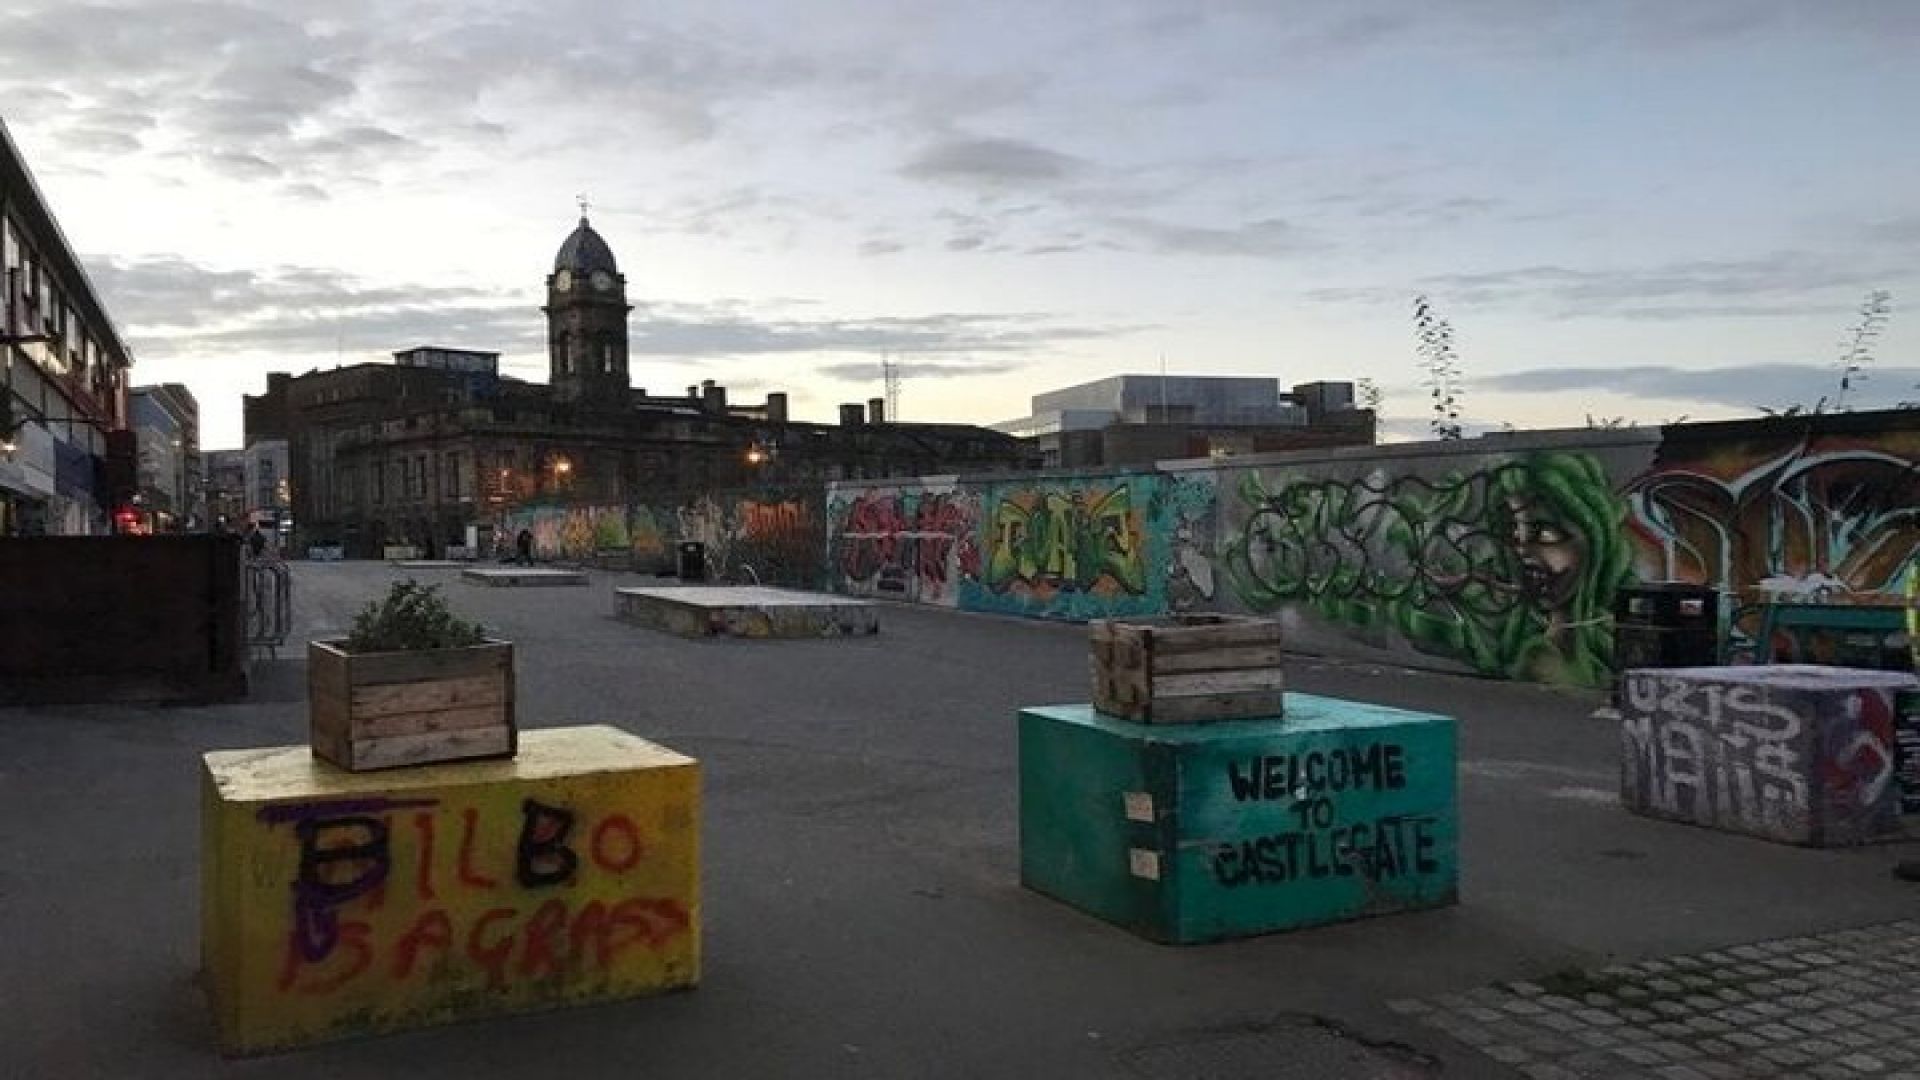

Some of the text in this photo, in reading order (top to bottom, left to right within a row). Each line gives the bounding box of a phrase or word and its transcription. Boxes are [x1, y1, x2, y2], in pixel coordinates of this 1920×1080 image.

[1228, 743, 1406, 801] WELCOME
[1289, 799, 1334, 829] TO
[293, 798, 641, 906] BILBO
[1213, 817, 1439, 885] CASTLEGATE
